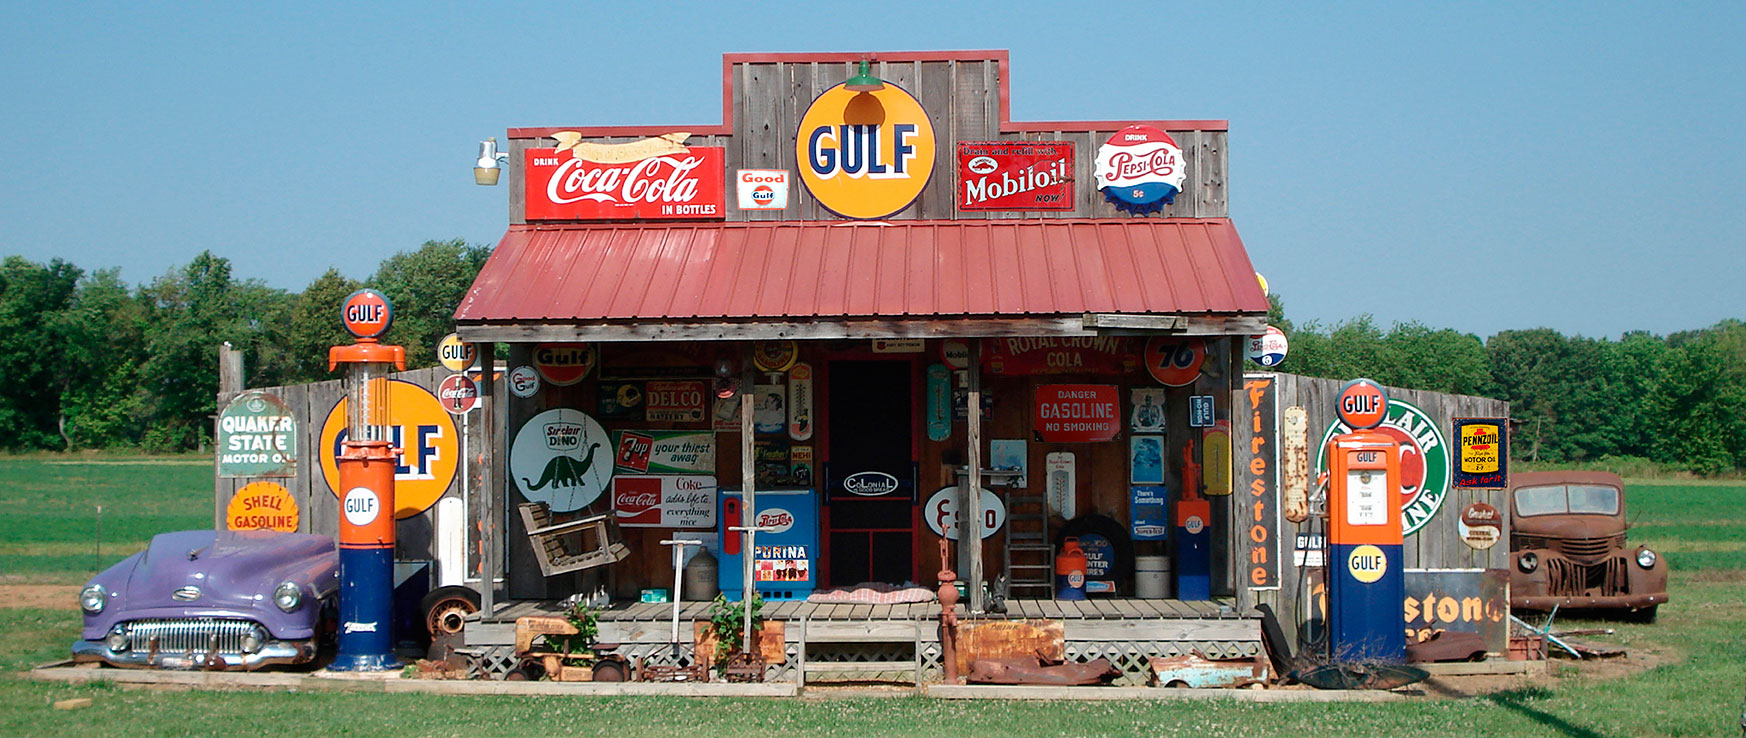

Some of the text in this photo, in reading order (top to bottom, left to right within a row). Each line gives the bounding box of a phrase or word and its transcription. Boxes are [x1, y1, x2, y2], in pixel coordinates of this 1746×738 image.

[808, 124, 918, 179] GULF
[964, 147, 989, 156] Drain
[992, 147, 1009, 156] and
[1012, 147, 1034, 156] refill
[1106, 148, 1176, 181] PEPSI-COLA
[548, 156, 705, 204] Coca-Cola
[742, 172, 784, 183] Good
[965, 158, 1066, 206] Mobiloil
[752, 190, 774, 200] Gulf
[1133, 190, 1144, 198] 5¢
[662, 204, 716, 214] IN BOTTLES
[348, 304, 384, 324] GULF
[442, 345, 473, 360] GULF
[1006, 337, 1120, 356] ROYAL CROWN
[538, 350, 590, 364] Gulf
[1047, 352, 1083, 368] COLA
[1158, 342, 1195, 368] 76
[513, 373, 536, 384] Good
[516, 380, 535, 391] Gulf
[442, 388, 474, 399] Coca-Cola
[648, 392, 701, 406] DELCO
[1058, 390, 1096, 399] DANGER
[1040, 402, 1114, 418] GASOLINE
[1343, 395, 1380, 414] GULF
[222, 416, 292, 434] QUAKER
[547, 426, 580, 436] Sinclair
[1046, 422, 1109, 432] NO SMOKING
[228, 435, 286, 450] STATE
[550, 437, 577, 446] DINO
[1463, 434, 1498, 446] PENNZOIL
[654, 442, 710, 456] your thirst
[222, 454, 268, 464] MOTOR
[670, 454, 697, 465] away
[1356, 452, 1377, 462] GULF
[676, 477, 702, 490] Coke
[1244, 380, 1271, 585] Firestone
[1459, 474, 1501, 486] Ask for it
[244, 495, 283, 510] SHELL
[346, 498, 374, 512] GULF
[616, 492, 658, 506] Coca-Cola
[666, 507, 710, 518] everything
[234, 516, 293, 528] GASOLINE
[680, 517, 697, 526] nice
[1186, 518, 1201, 528] GULF
[756, 546, 806, 558] PURINA
[1352, 555, 1382, 570] GULF
